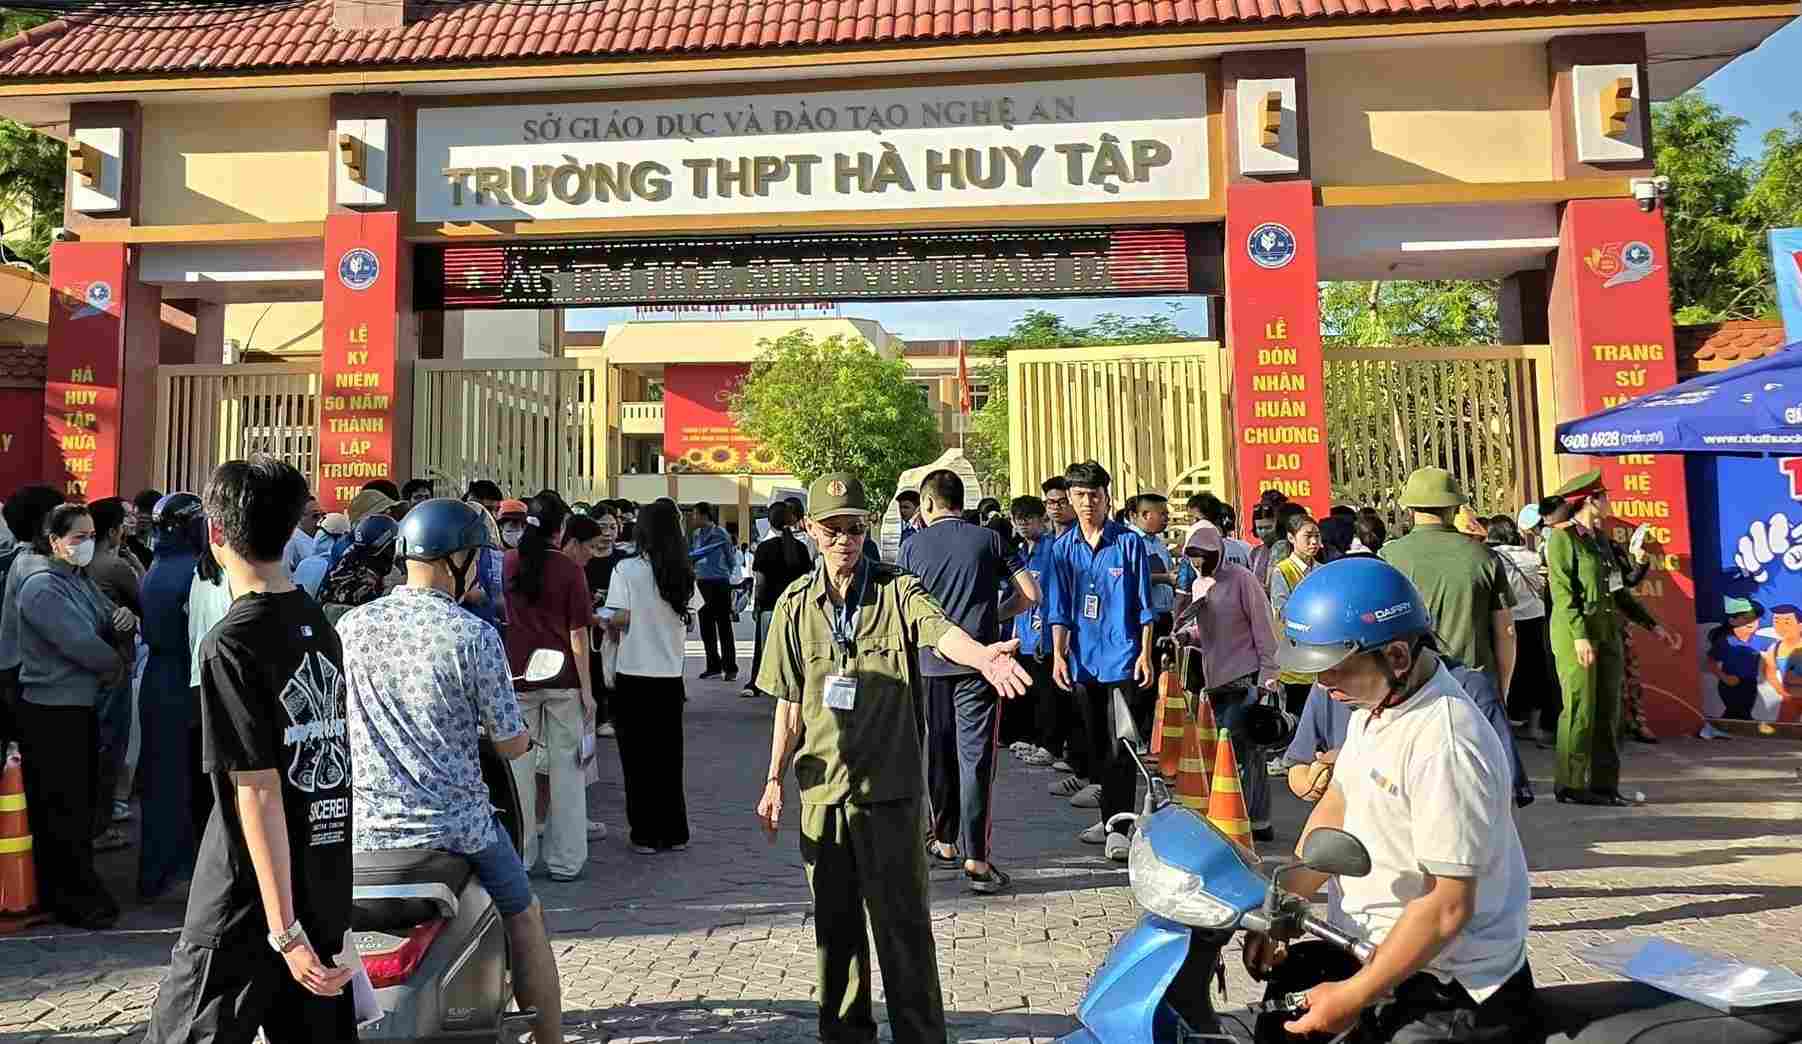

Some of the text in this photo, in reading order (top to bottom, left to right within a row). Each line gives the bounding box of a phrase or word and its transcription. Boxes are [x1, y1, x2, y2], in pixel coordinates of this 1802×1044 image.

[523, 95, 1077, 143] SỞ GIÁO DỤC VÀ ĐÀO TẠO NGHỆ AN
[442, 132, 1173, 206] TRƯỜNG THPT HÀ HUY TẬP
[1258, 345, 1297, 366] ĐÓN
[1591, 344, 1664, 361] TRANG
[1252, 371, 1305, 395] NHẬN
[1615, 363, 1647, 387] SỬ
[65, 390, 97, 405] HUY
[324, 392, 389, 411] 50 NĂM
[1254, 398, 1307, 417] HUÂN
[328, 414, 385, 433] THÀNH
[1243, 424, 1320, 444] CHƯƠNG
[1590, 431, 1620, 448] 6928
[322, 457, 388, 477] TRƯỜNG
[1265, 453, 1300, 470] LAO
[1623, 470, 1652, 495] HỆ
